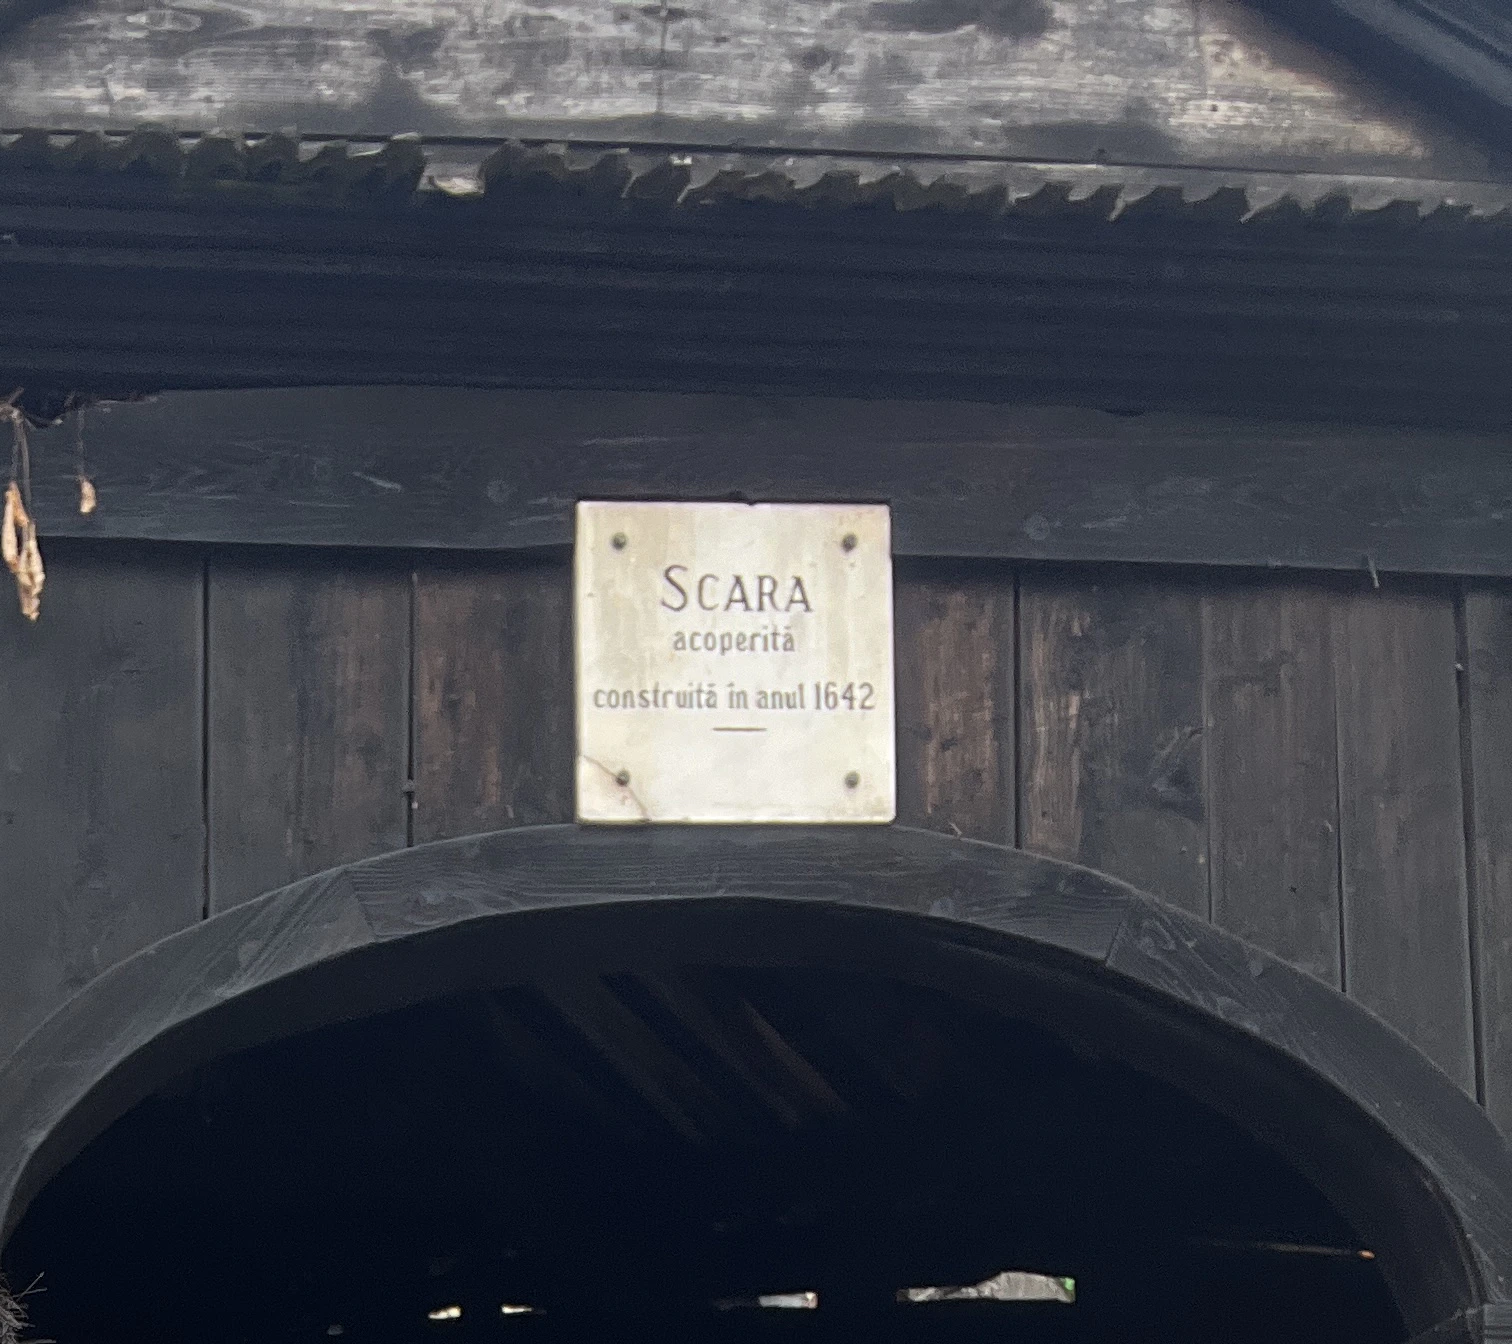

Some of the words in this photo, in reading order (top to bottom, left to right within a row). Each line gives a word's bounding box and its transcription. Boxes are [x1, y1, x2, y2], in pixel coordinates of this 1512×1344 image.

[661, 565, 813, 613] SCARA
[673, 624, 796, 656] acoperită
[593, 682, 718, 711] construită
[727, 682, 748, 710] în
[756, 682, 805, 710] anul
[814, 681, 876, 712] 1642
